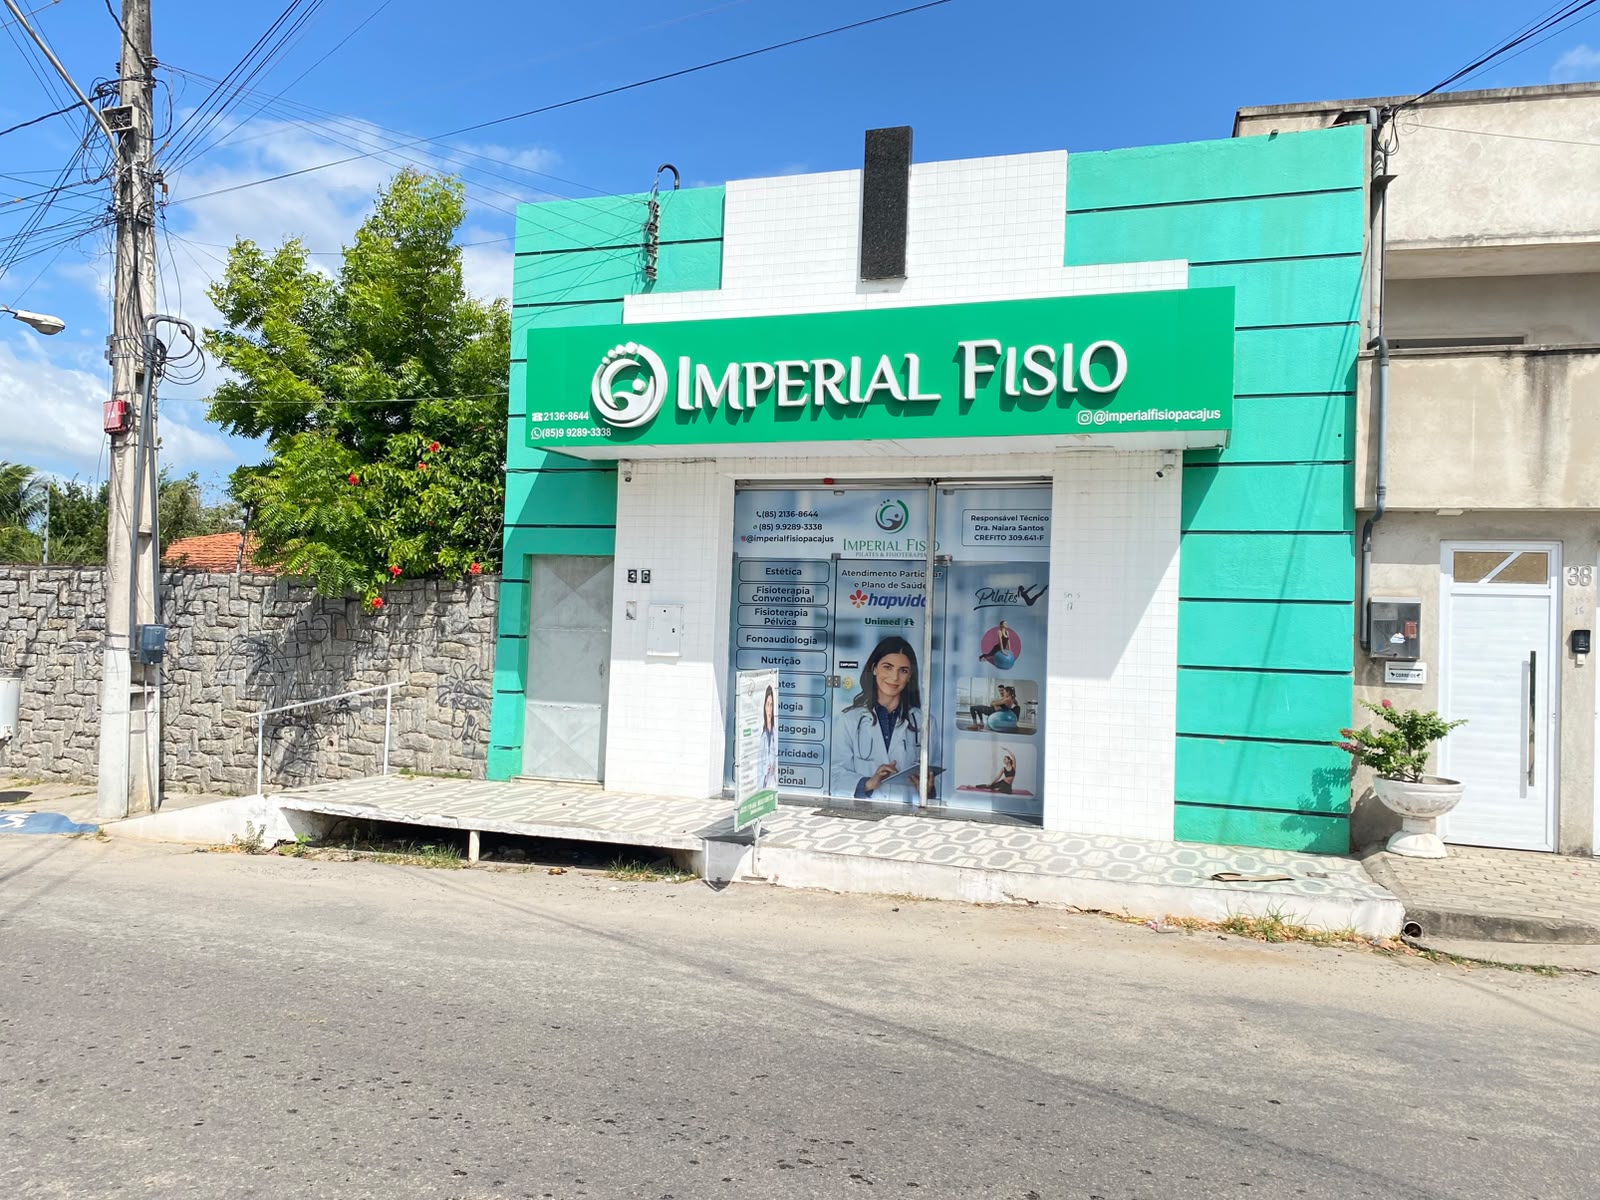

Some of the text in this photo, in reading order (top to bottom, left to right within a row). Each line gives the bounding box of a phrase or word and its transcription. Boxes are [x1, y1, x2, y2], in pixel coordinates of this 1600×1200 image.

[543, 411, 589, 421] 2136-8644
[1094, 408, 1221, 425] @imperialfisiopacajus
[542, 427, 611, 439] (85)9 9289-3338
[762, 511, 776, 519] (85)
[1020, 514, 1050, 522] Técnico
[759, 523, 774, 531] (85)
[746, 535, 834, 543] @imperialfisiopacajus
[628, 569, 651, 583] 36
[765, 567, 802, 576] Estética
[1567, 565, 1593, 586] 38
[756, 586, 810, 596] Fisioterapia
[975, 587, 1018, 604] Pilates
[752, 594, 815, 603] Convencional
[754, 608, 808, 618] Fisioterapia
[764, 617, 797, 625] Pélvica
[864, 617, 901, 626] Unimed
[746, 634, 818, 646] Fonoaudiologia
[761, 656, 801, 666] Nutrição
